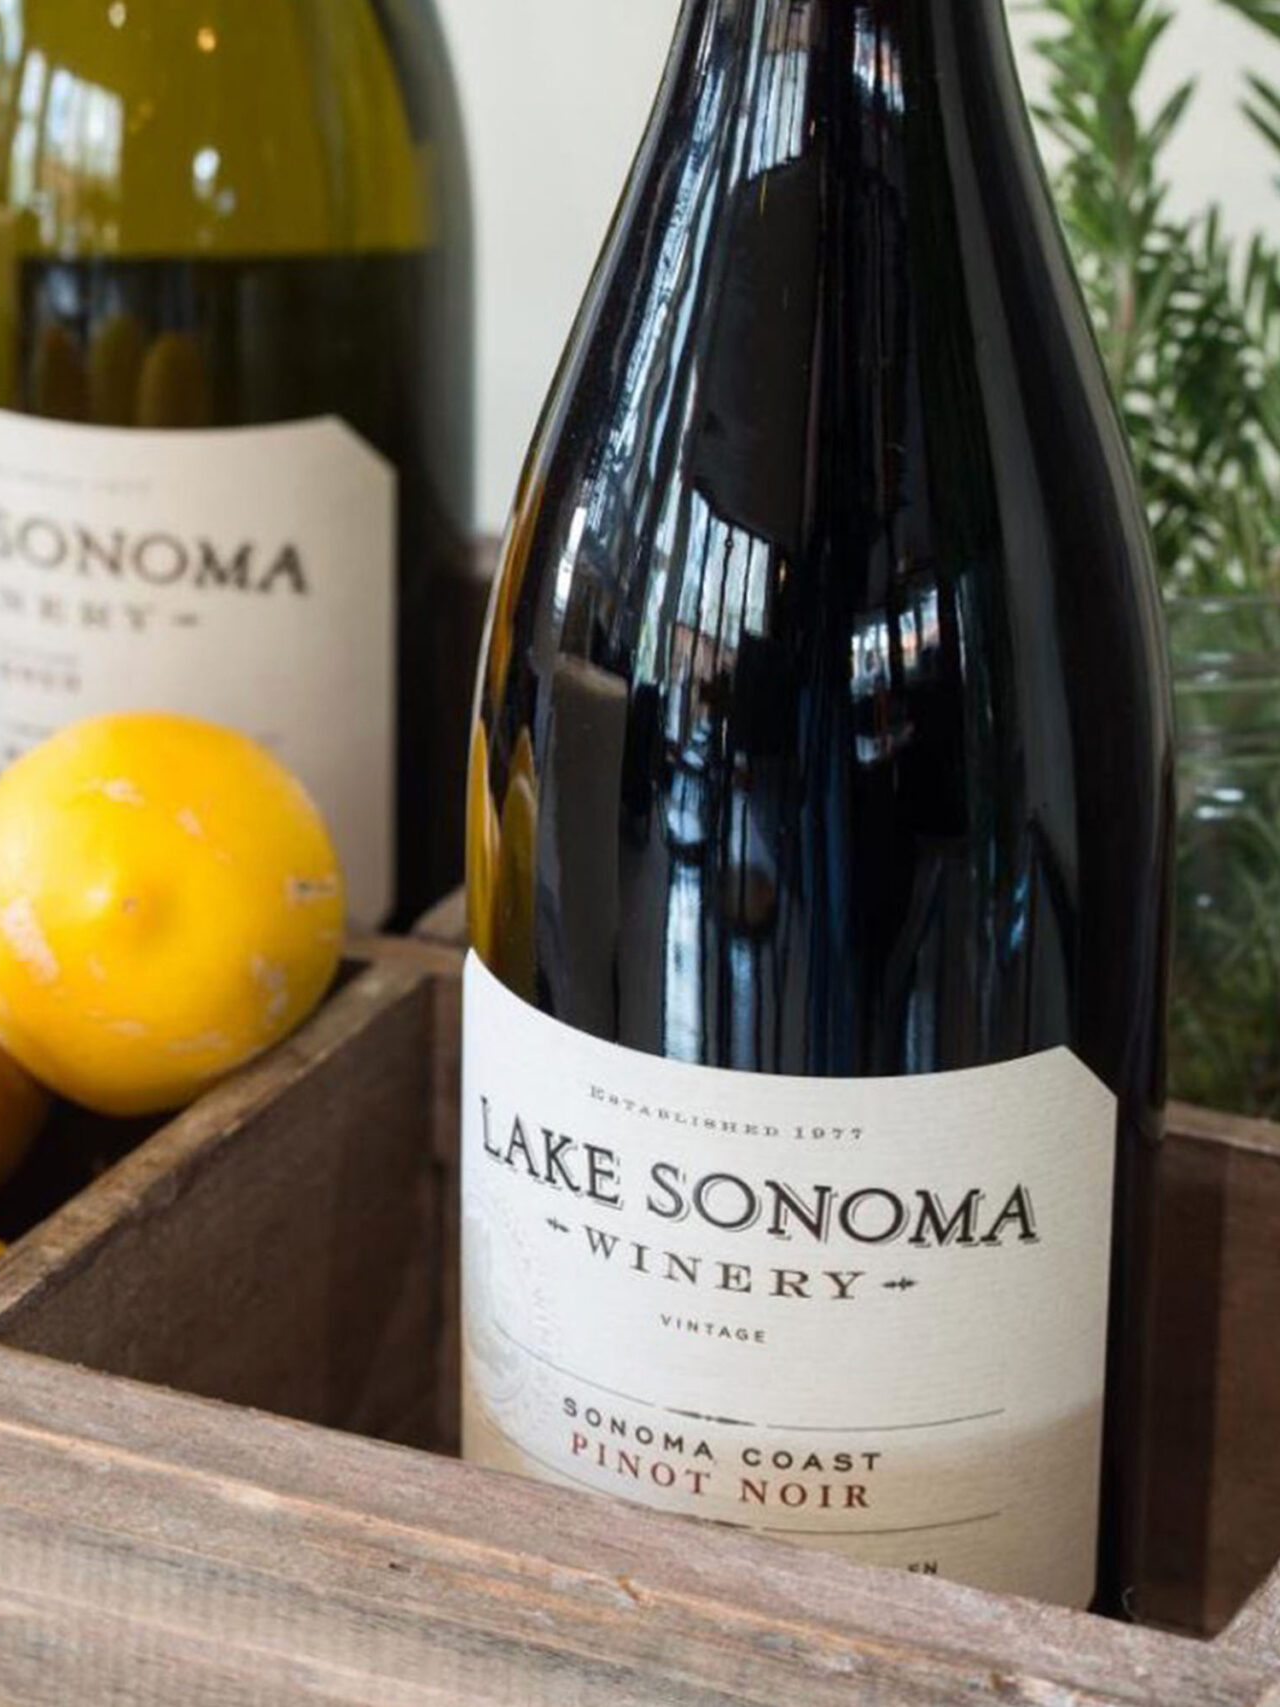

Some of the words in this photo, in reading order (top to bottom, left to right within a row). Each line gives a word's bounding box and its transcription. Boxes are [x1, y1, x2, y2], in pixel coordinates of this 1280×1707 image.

[590, 1085, 779, 1138] ESTABLISHED
[794, 1126, 865, 1141] 1977
[480, 1095, 622, 1211] LAKE
[647, 1162, 1040, 1247] SONOMA
[583, 1225, 866, 1300] WINERY
[660, 1314, 767, 1343] VINTAGE
[563, 1397, 715, 1462] SONOMA
[742, 1447, 882, 1472] COAST
[571, 1432, 712, 1496] PINOT
[740, 1480, 870, 1509] NOIR
